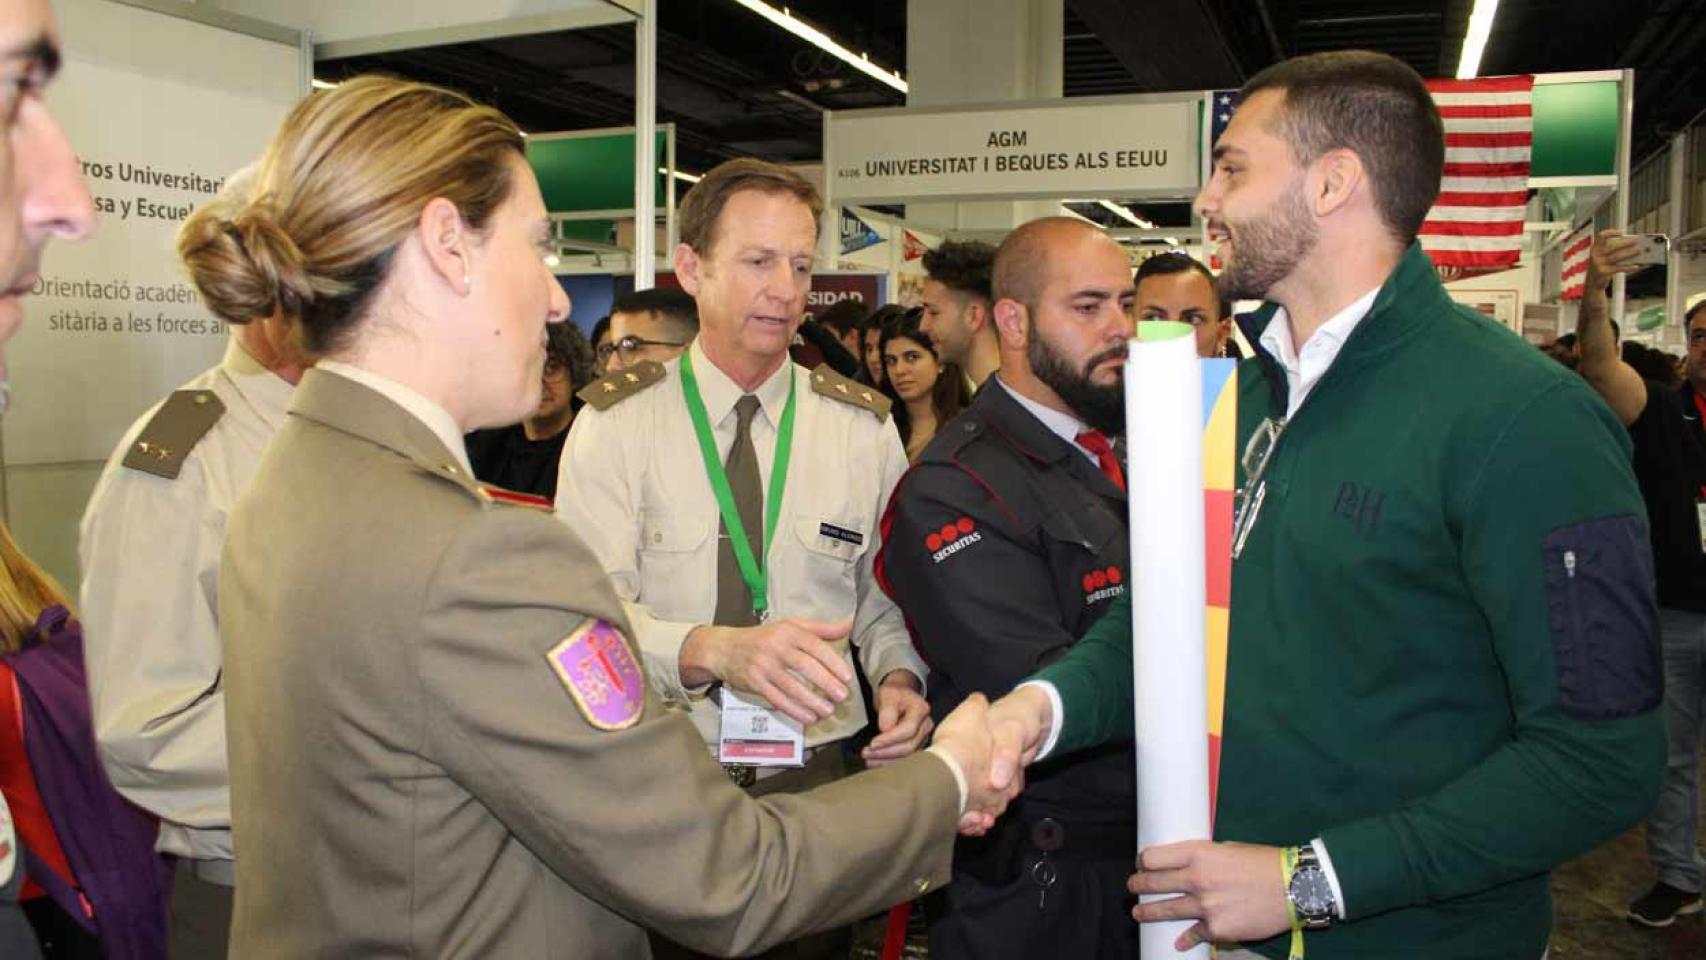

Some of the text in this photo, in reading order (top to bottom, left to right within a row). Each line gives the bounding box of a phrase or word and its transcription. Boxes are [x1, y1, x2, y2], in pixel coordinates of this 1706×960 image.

[987, 130, 1027, 147] AGM
[77, 157, 113, 180] ros
[865, 149, 1168, 177] UNIVERSITAT I BEQUES ALS EEUU
[89, 196, 116, 213] sa
[120, 198, 131, 220] y
[31, 274, 131, 300] Orientació
[49, 309, 107, 332] sitària
[112, 317, 123, 332] a
[128, 312, 152, 333] les
[157, 313, 207, 334] forces
[933, 531, 981, 563] SECURITAS
